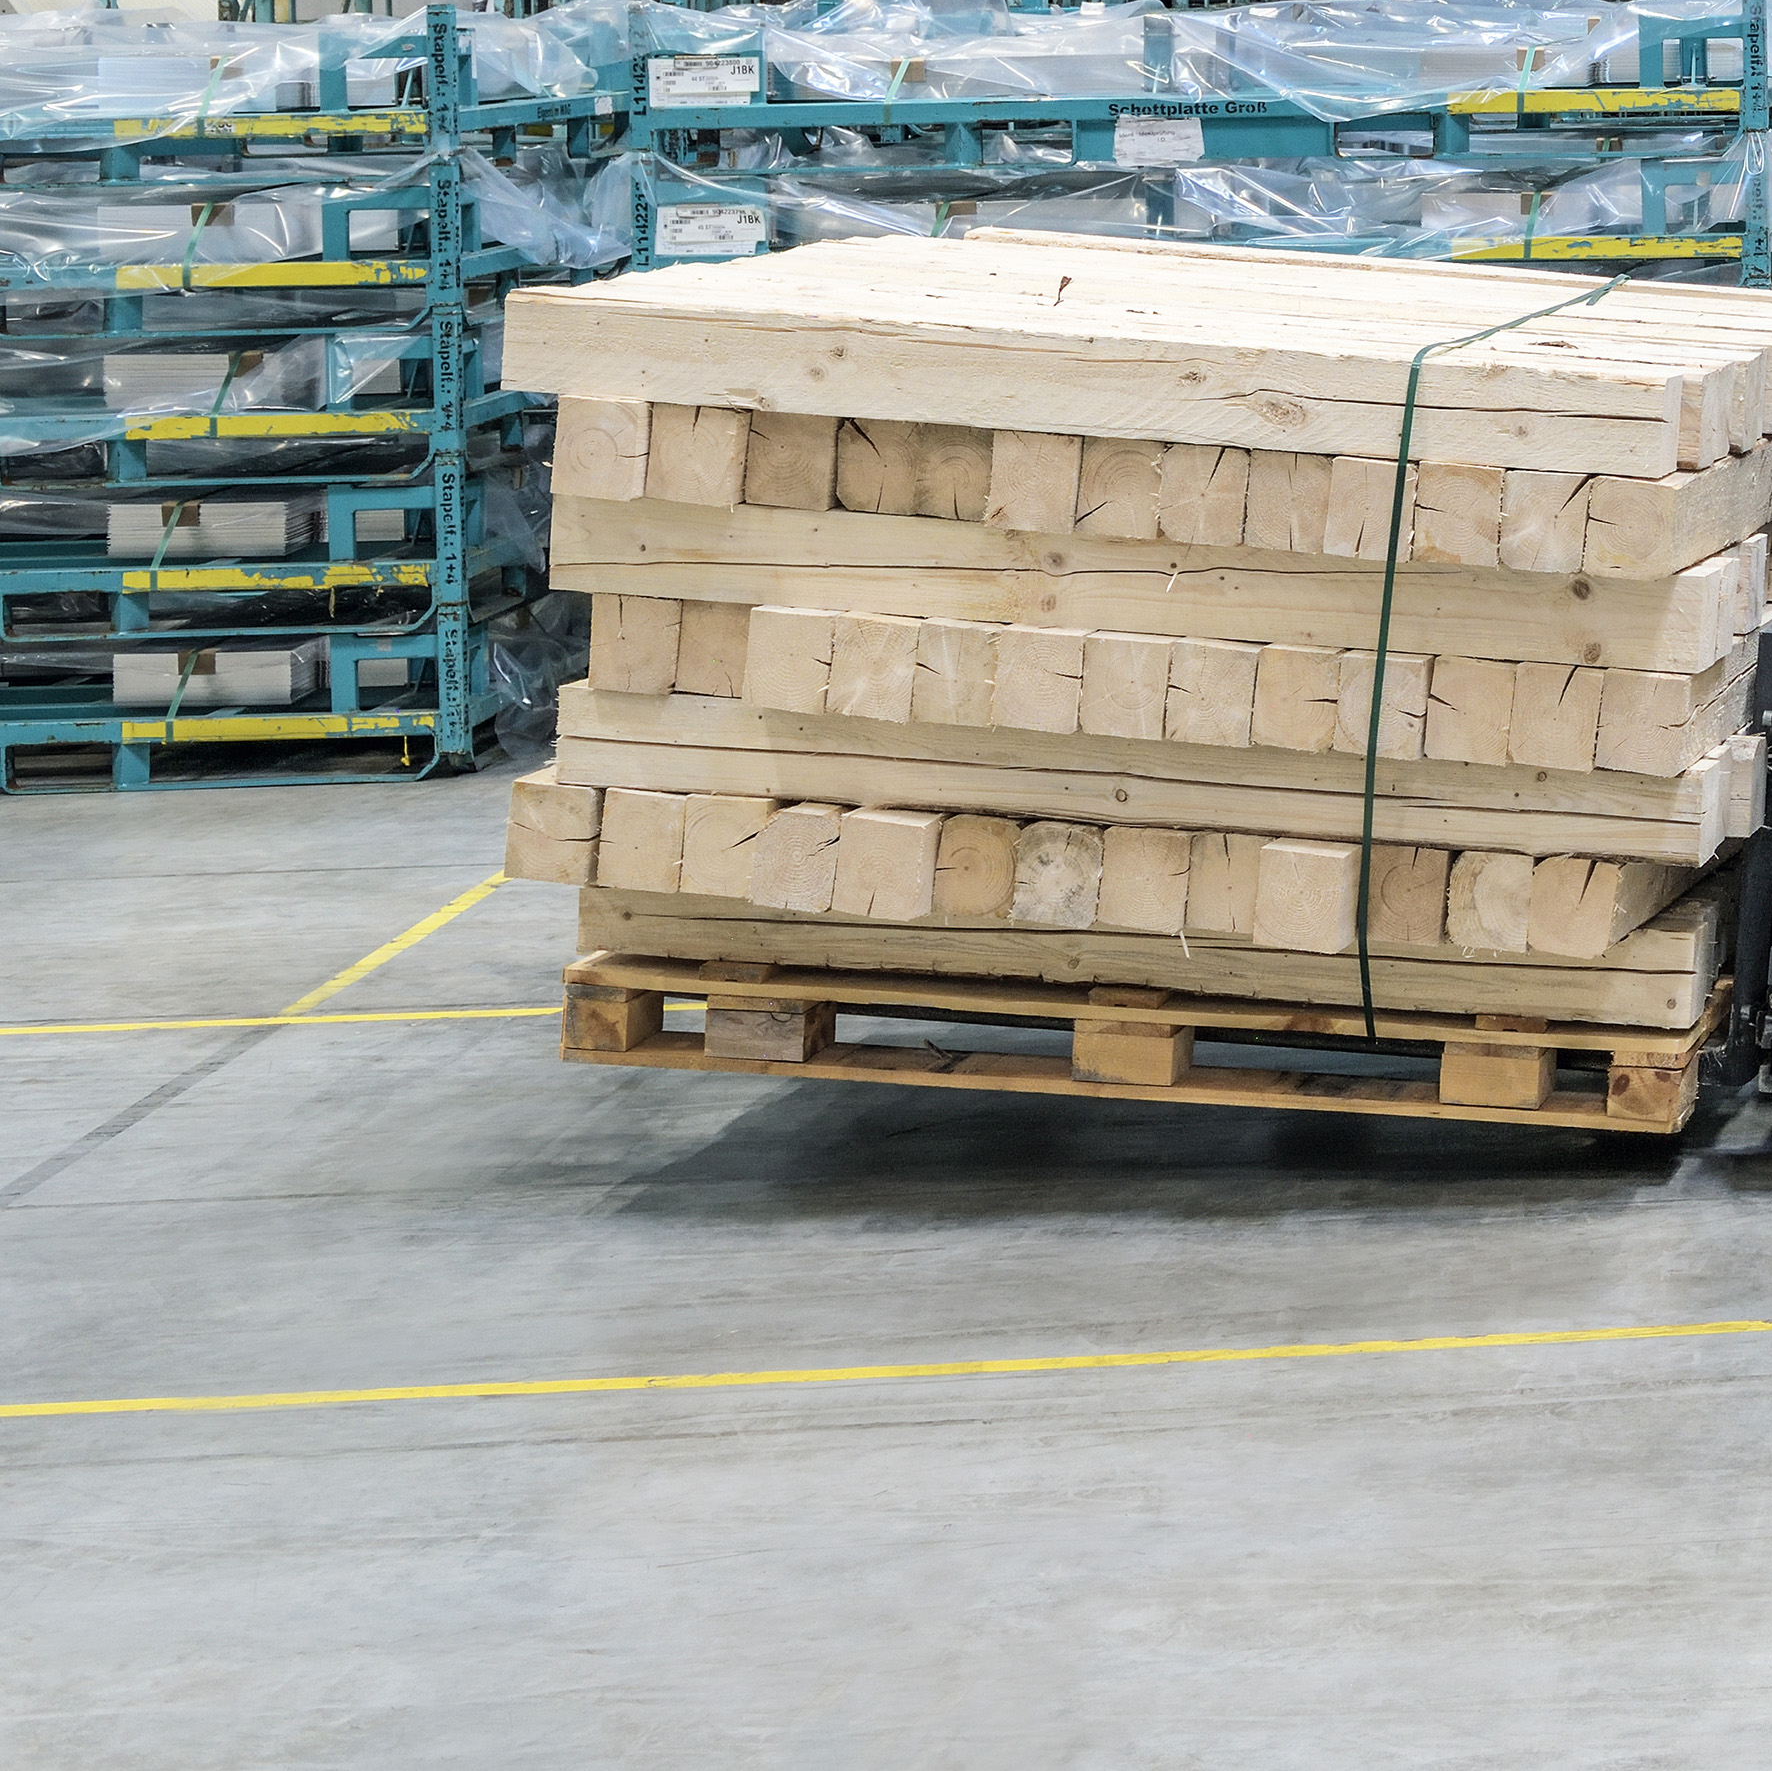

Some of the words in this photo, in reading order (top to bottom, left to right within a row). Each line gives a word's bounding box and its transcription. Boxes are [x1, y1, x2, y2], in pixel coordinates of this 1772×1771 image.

[731, 65, 755, 75] J1BK
[1108, 102, 1219, 118] Schottplatte
[1225, 101, 1268, 114] Groß
[737, 214, 761, 224] J1BK
